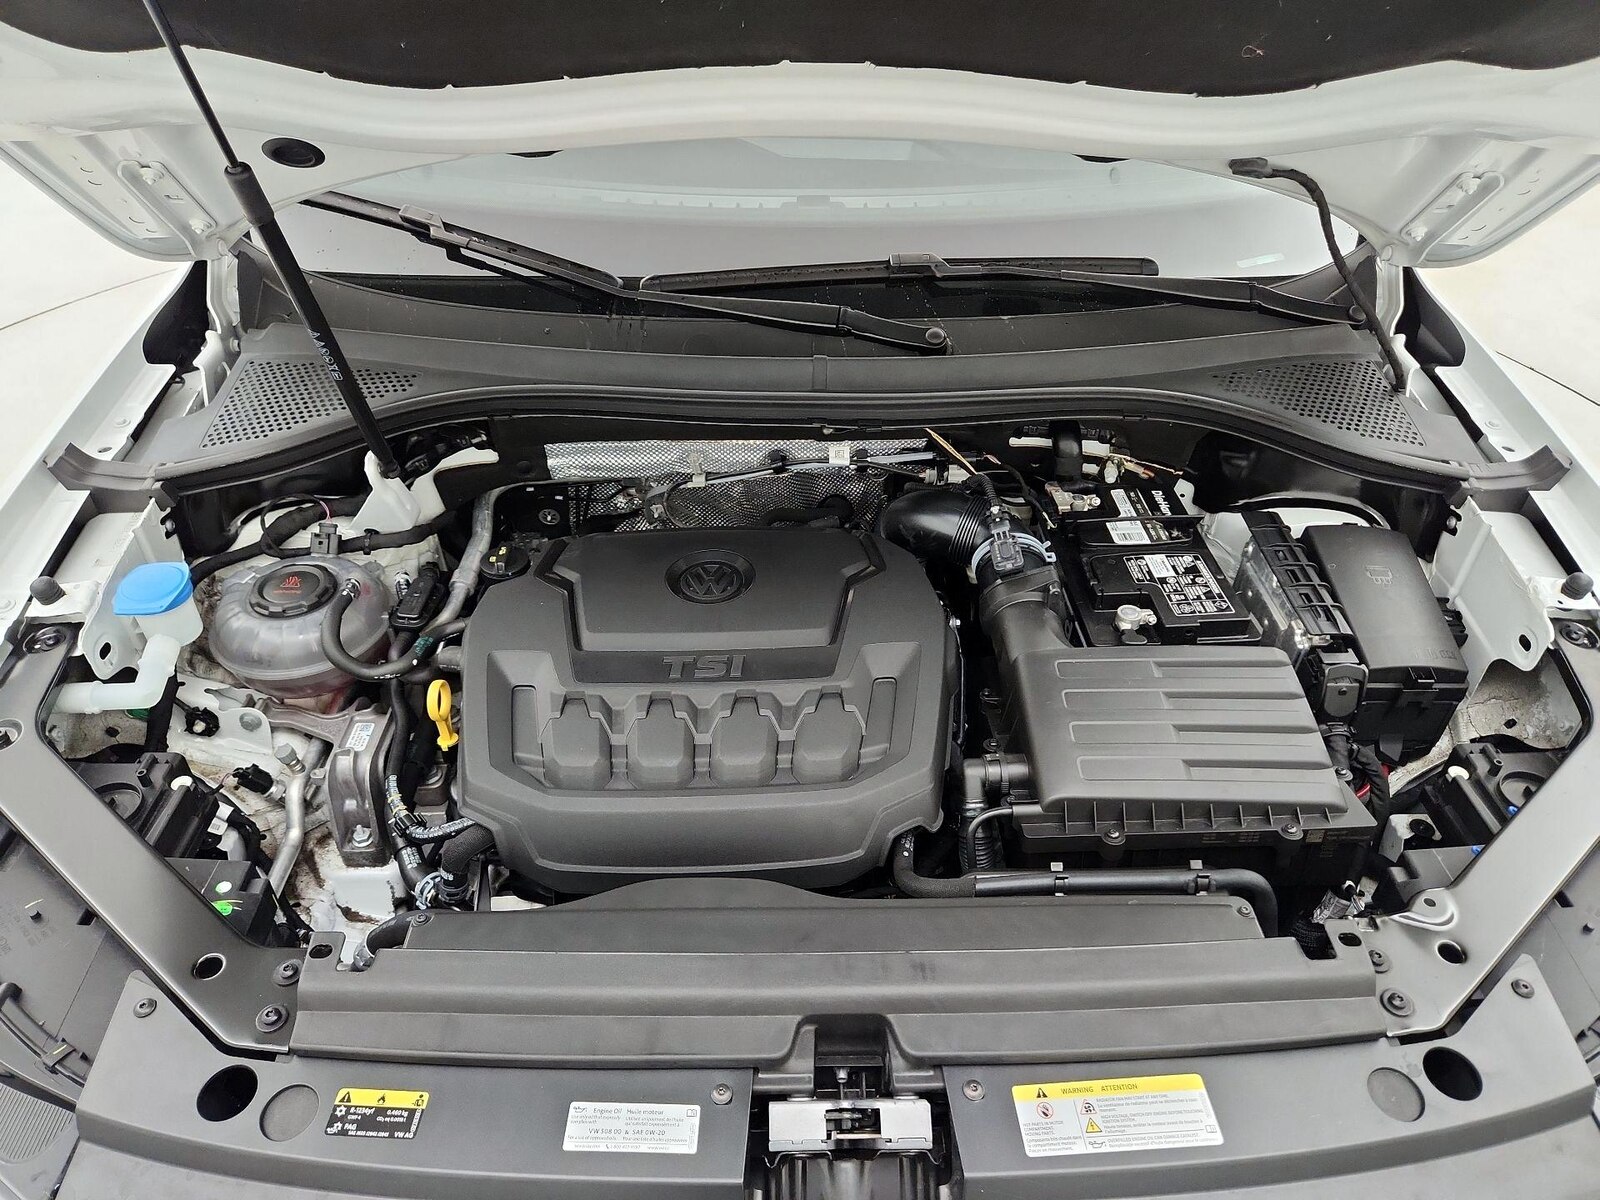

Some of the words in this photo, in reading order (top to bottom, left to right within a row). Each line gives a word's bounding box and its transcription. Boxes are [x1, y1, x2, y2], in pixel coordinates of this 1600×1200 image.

[1151, 490, 1172, 516] DieHar
[662, 654, 747, 679] TSI
[1061, 1087, 1094, 1095] WARNING
[1100, 1083, 1138, 1092] ATTENTION
[350, 1107, 375, 1115] R-1234yf
[593, 1107, 612, 1115] Engine
